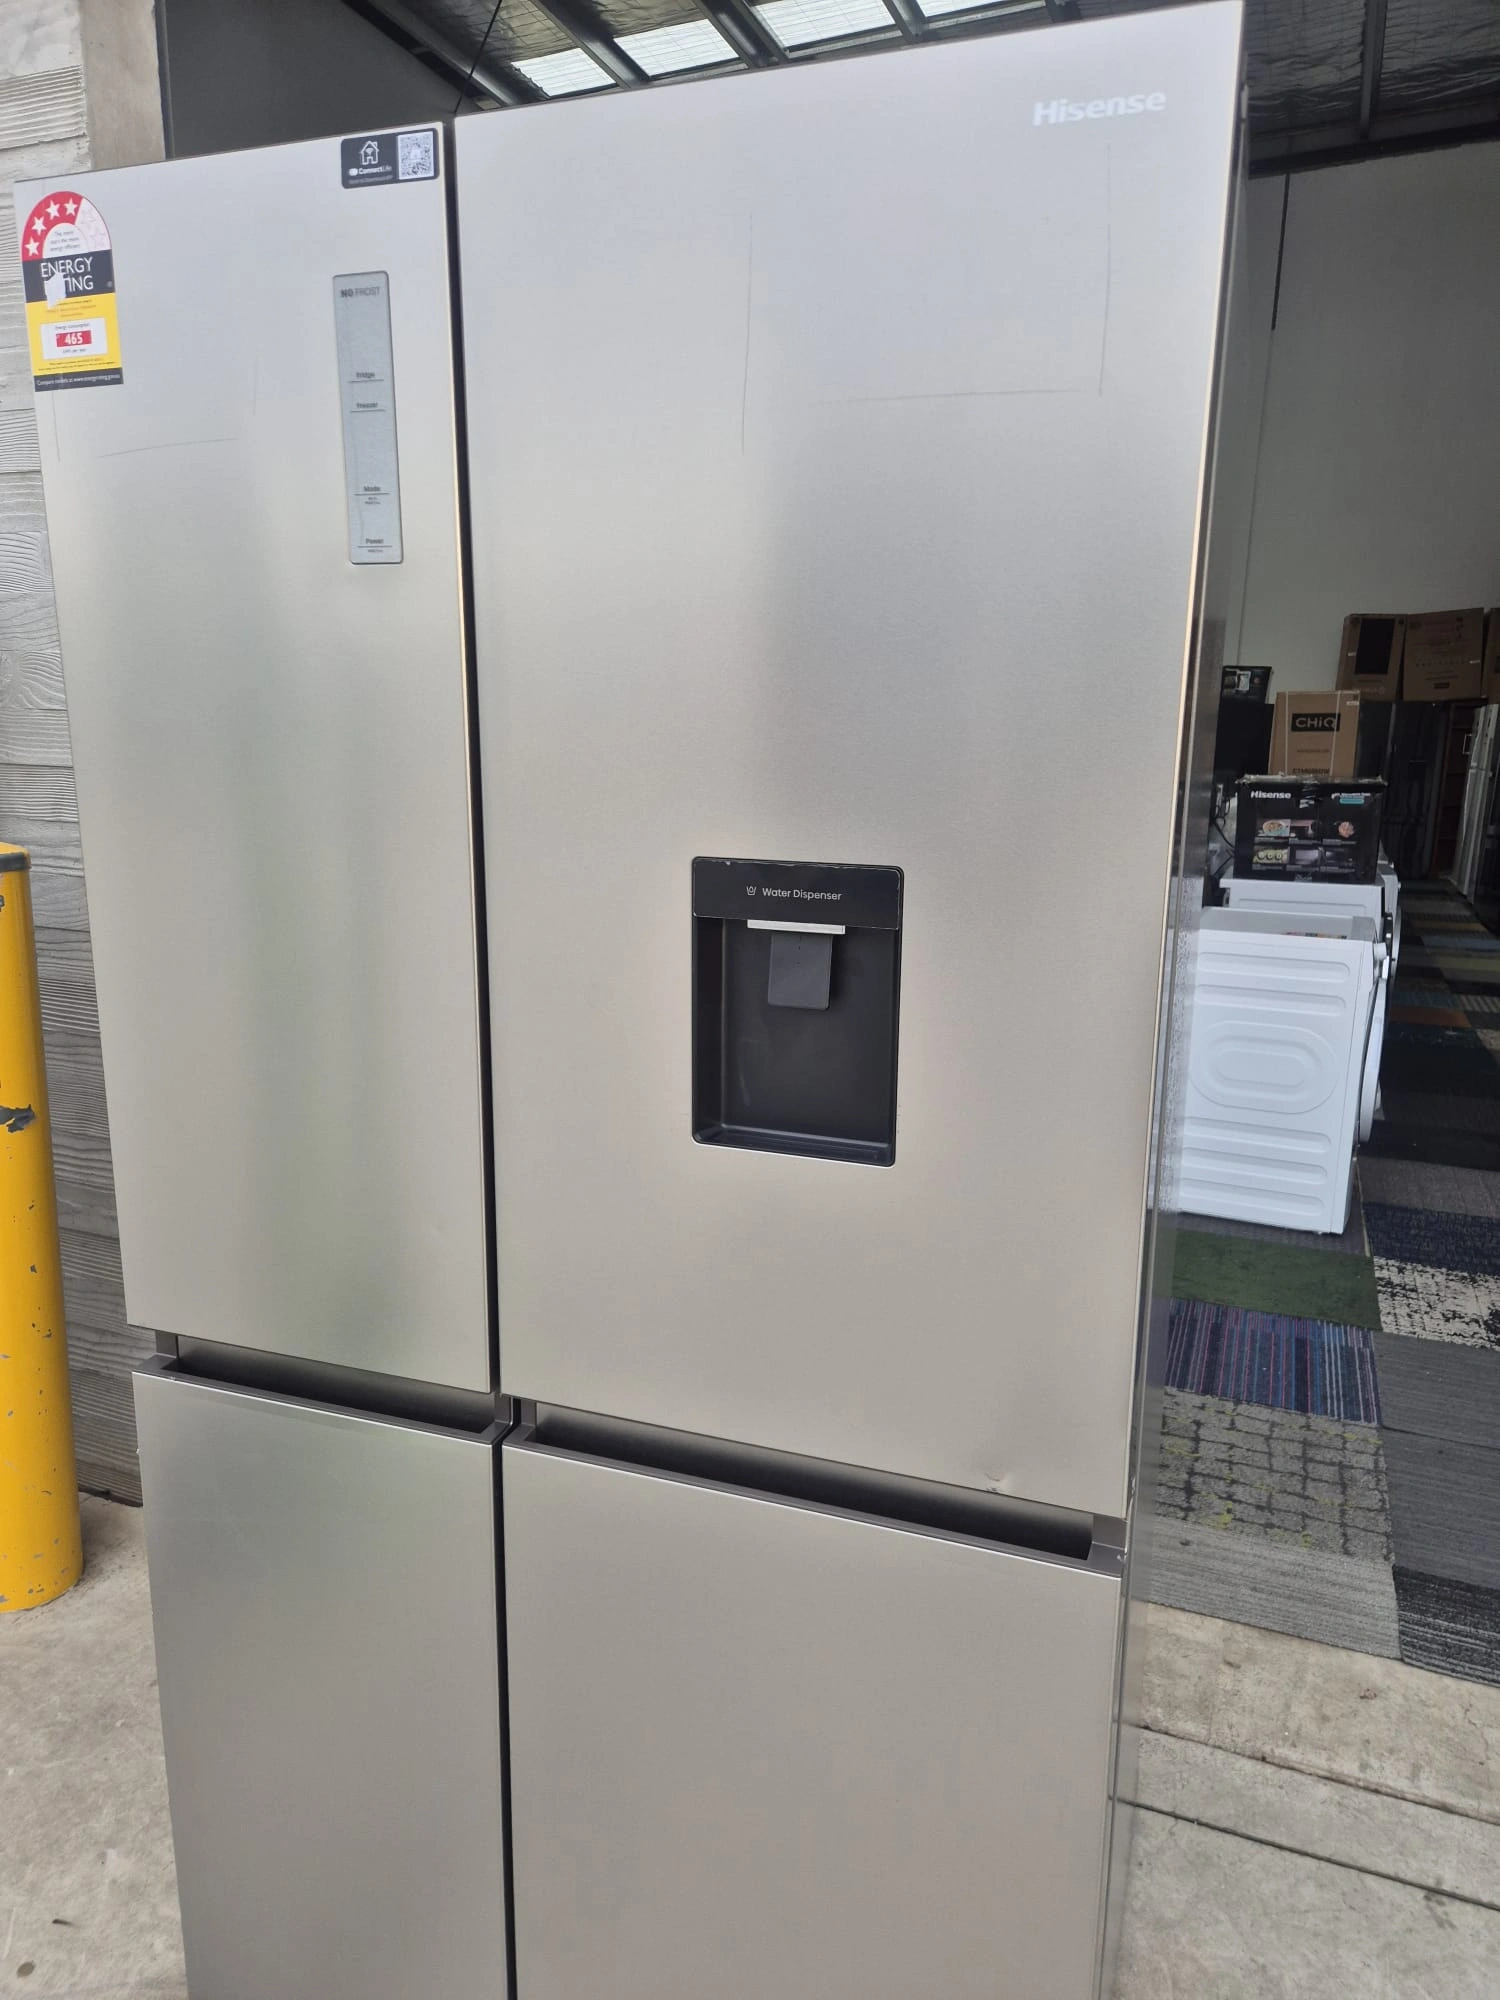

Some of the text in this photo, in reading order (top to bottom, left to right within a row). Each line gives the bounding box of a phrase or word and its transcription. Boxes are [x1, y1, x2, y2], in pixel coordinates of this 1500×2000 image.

[1032, 91, 1167, 126] Hisense
[40, 256, 93, 278] ENERGY
[340, 286, 381, 298] NO FROST
[65, 332, 83, 345] 465
[1295, 716, 1337, 729] CHiQ
[1250, 790, 1292, 799] Hisense
[762, 887, 842, 901] Water Dispenser
